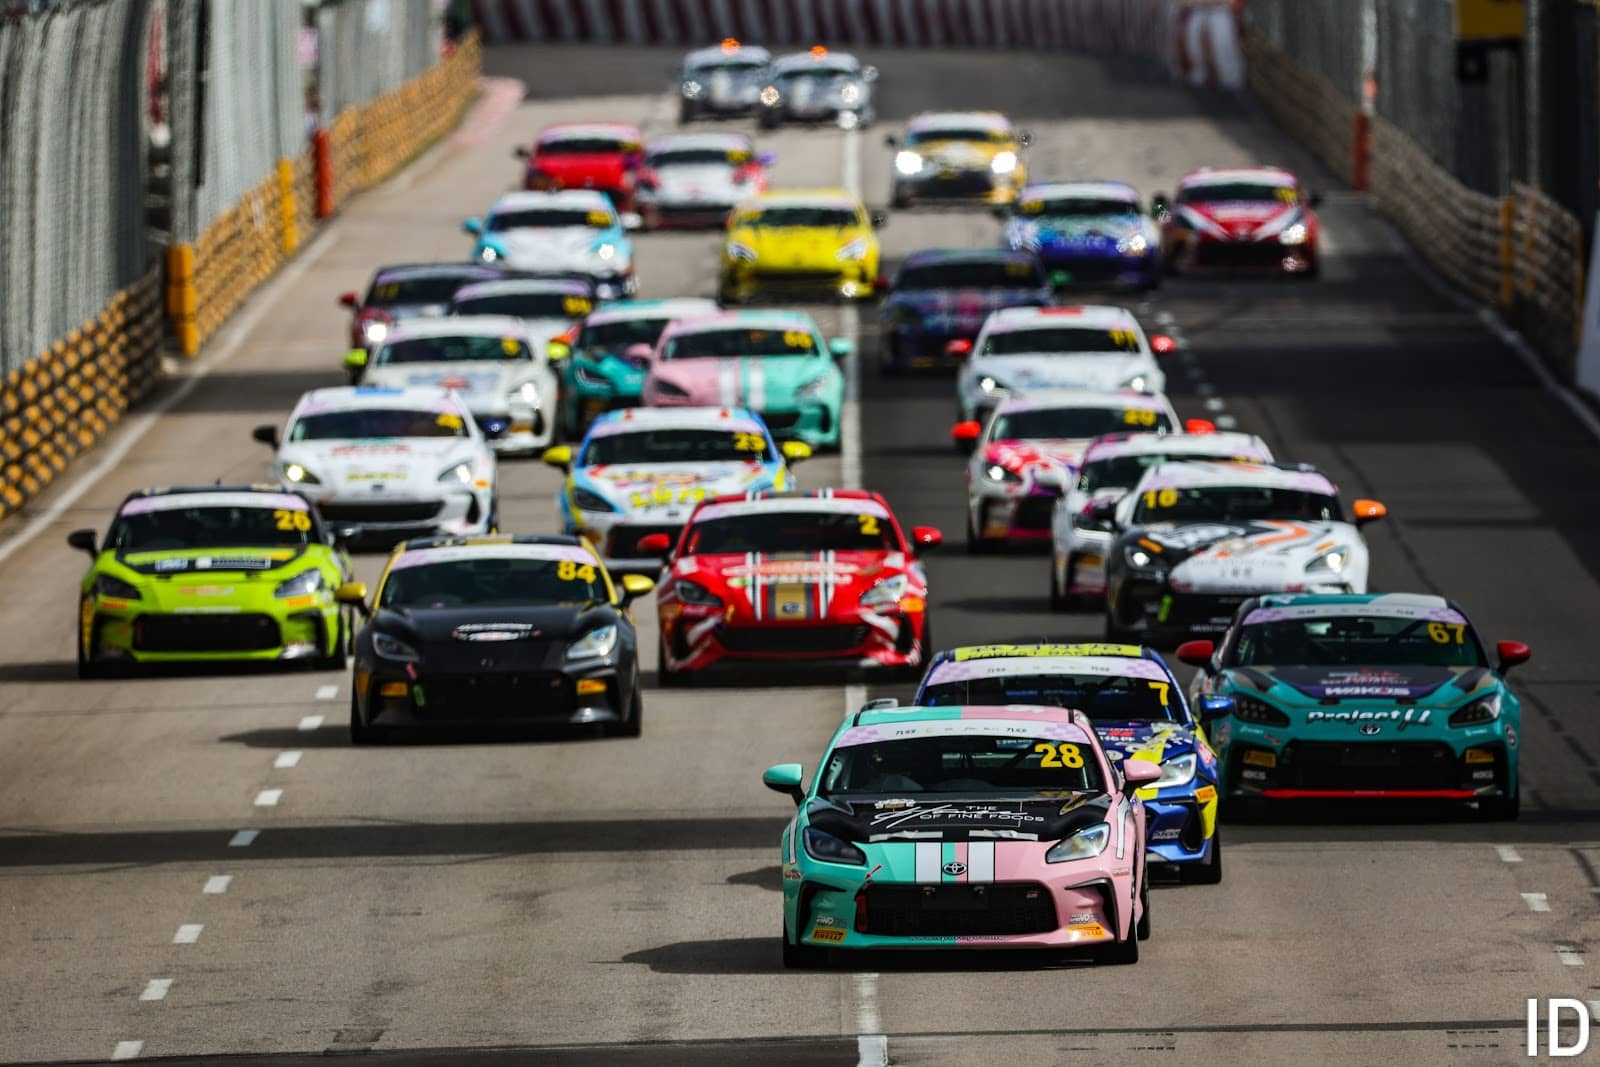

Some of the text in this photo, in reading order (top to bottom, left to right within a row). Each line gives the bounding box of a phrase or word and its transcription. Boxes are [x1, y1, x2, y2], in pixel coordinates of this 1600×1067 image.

[273, 510, 312, 532] 26
[857, 513, 881, 536] 2
[556, 560, 597, 584] 84
[1428, 621, 1465, 645] 67
[1148, 680, 1170, 707] 7
[1033, 743, 1085, 769] 28
[919, 812, 1046, 823] OF FINE FOODS
[965, 804, 998, 812] THE
